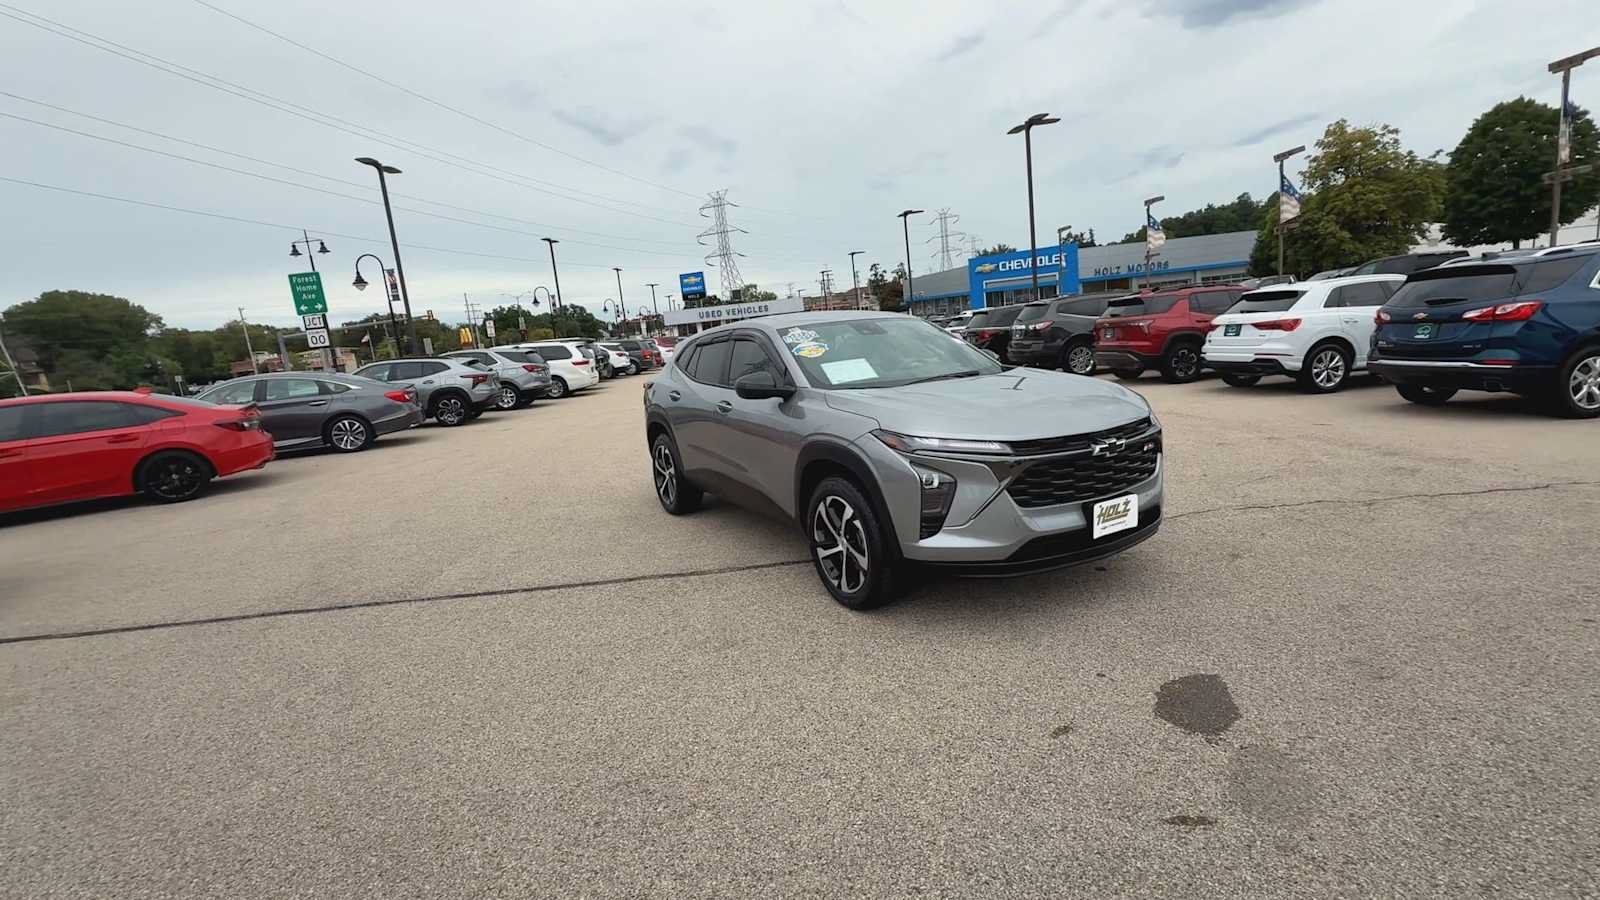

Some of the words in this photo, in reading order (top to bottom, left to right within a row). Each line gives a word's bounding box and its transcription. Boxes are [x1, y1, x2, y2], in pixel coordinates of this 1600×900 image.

[1094, 265, 1120, 276] HOLZ
[1127, 260, 1169, 273] MOTORS
[292, 275, 317, 283] Forest
[698, 309, 722, 319] USED
[725, 304, 769, 316] VEHICLES
[306, 316, 322, 327] JCT
[1096, 498, 1131, 526] HOLZ
